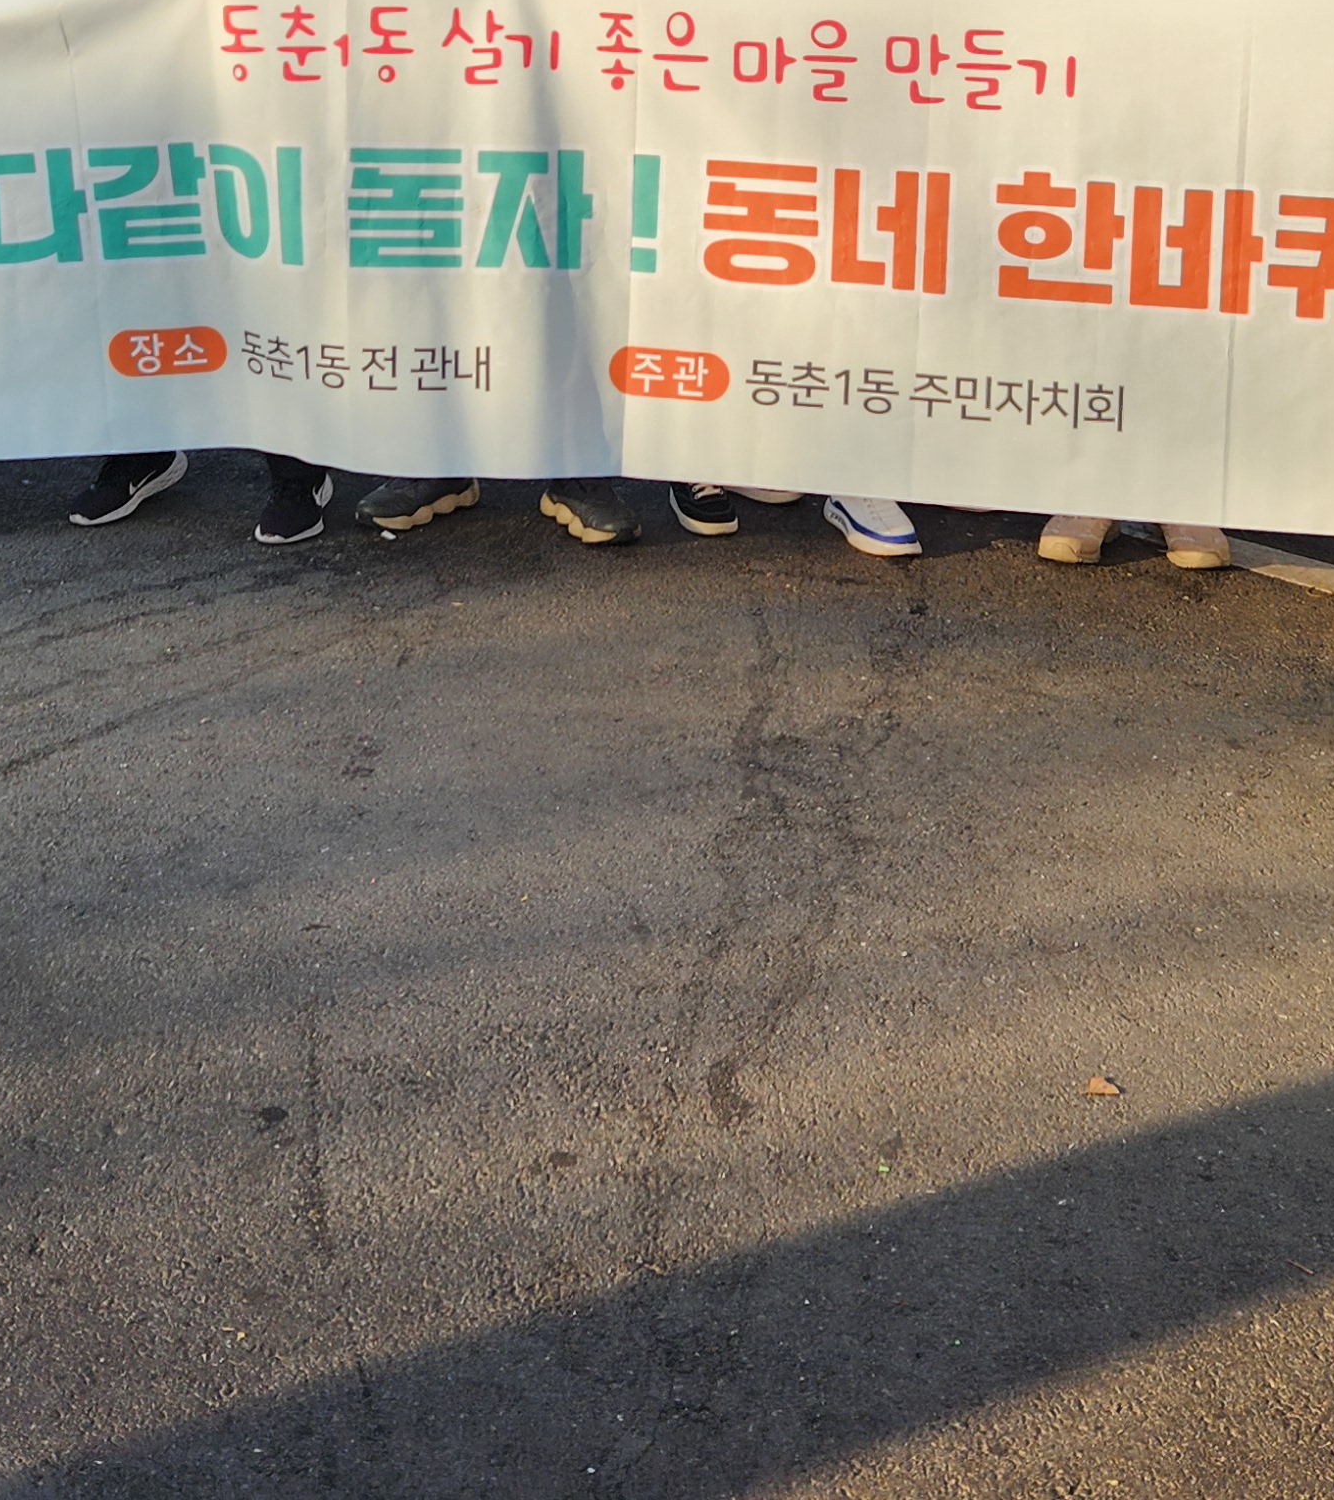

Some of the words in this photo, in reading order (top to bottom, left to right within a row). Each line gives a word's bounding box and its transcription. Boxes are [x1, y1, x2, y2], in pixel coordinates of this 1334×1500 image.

[220, 4, 415, 83] 동춘1동
[441, 8, 560, 85] 살기
[597, 11, 710, 91] 좋은
[733, 19, 859, 103] 마을
[884, 29, 1078, 111] 만들기
[702, 158, 951, 296] 동네
[129, 333, 208, 375] 장소
[240, 330, 351, 390] 동춘1동
[361, 345, 398, 392] 전
[410, 344, 492, 393] 관내
[630, 352, 709, 398] 주관
[745, 359, 900, 416] 동춘1동
[909, 371, 1125, 432] 주민자치회
